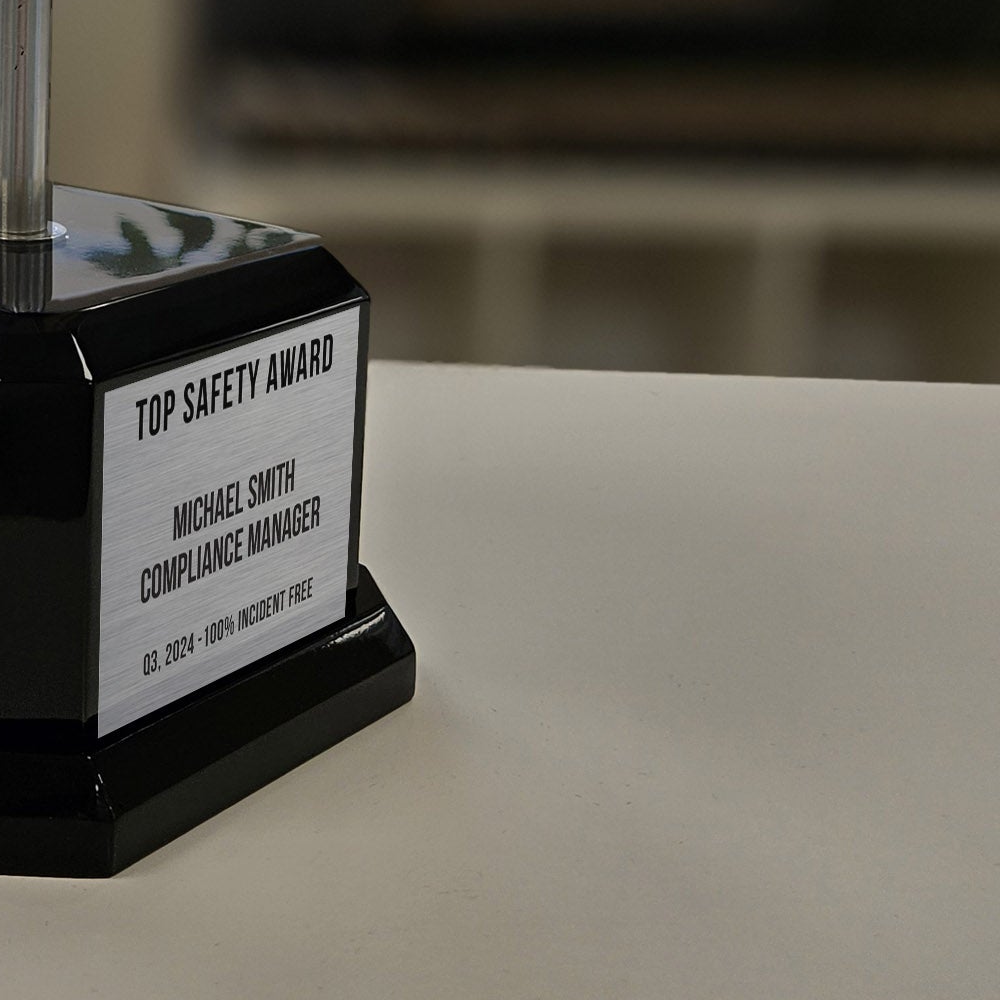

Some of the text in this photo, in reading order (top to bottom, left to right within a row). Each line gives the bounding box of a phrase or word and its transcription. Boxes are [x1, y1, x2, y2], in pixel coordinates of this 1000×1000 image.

[136, 333, 334, 441] TOP SAFETY AWARD
[140, 495, 321, 603] COMPLIANCE MANAGER
[172, 458, 295, 541] MICHAEL SMITH
[143, 650, 161, 676] Q3,
[165, 633, 195, 666] 2024
[238, 589, 286, 631] INCIDENT
[289, 577, 313, 608] FREE
